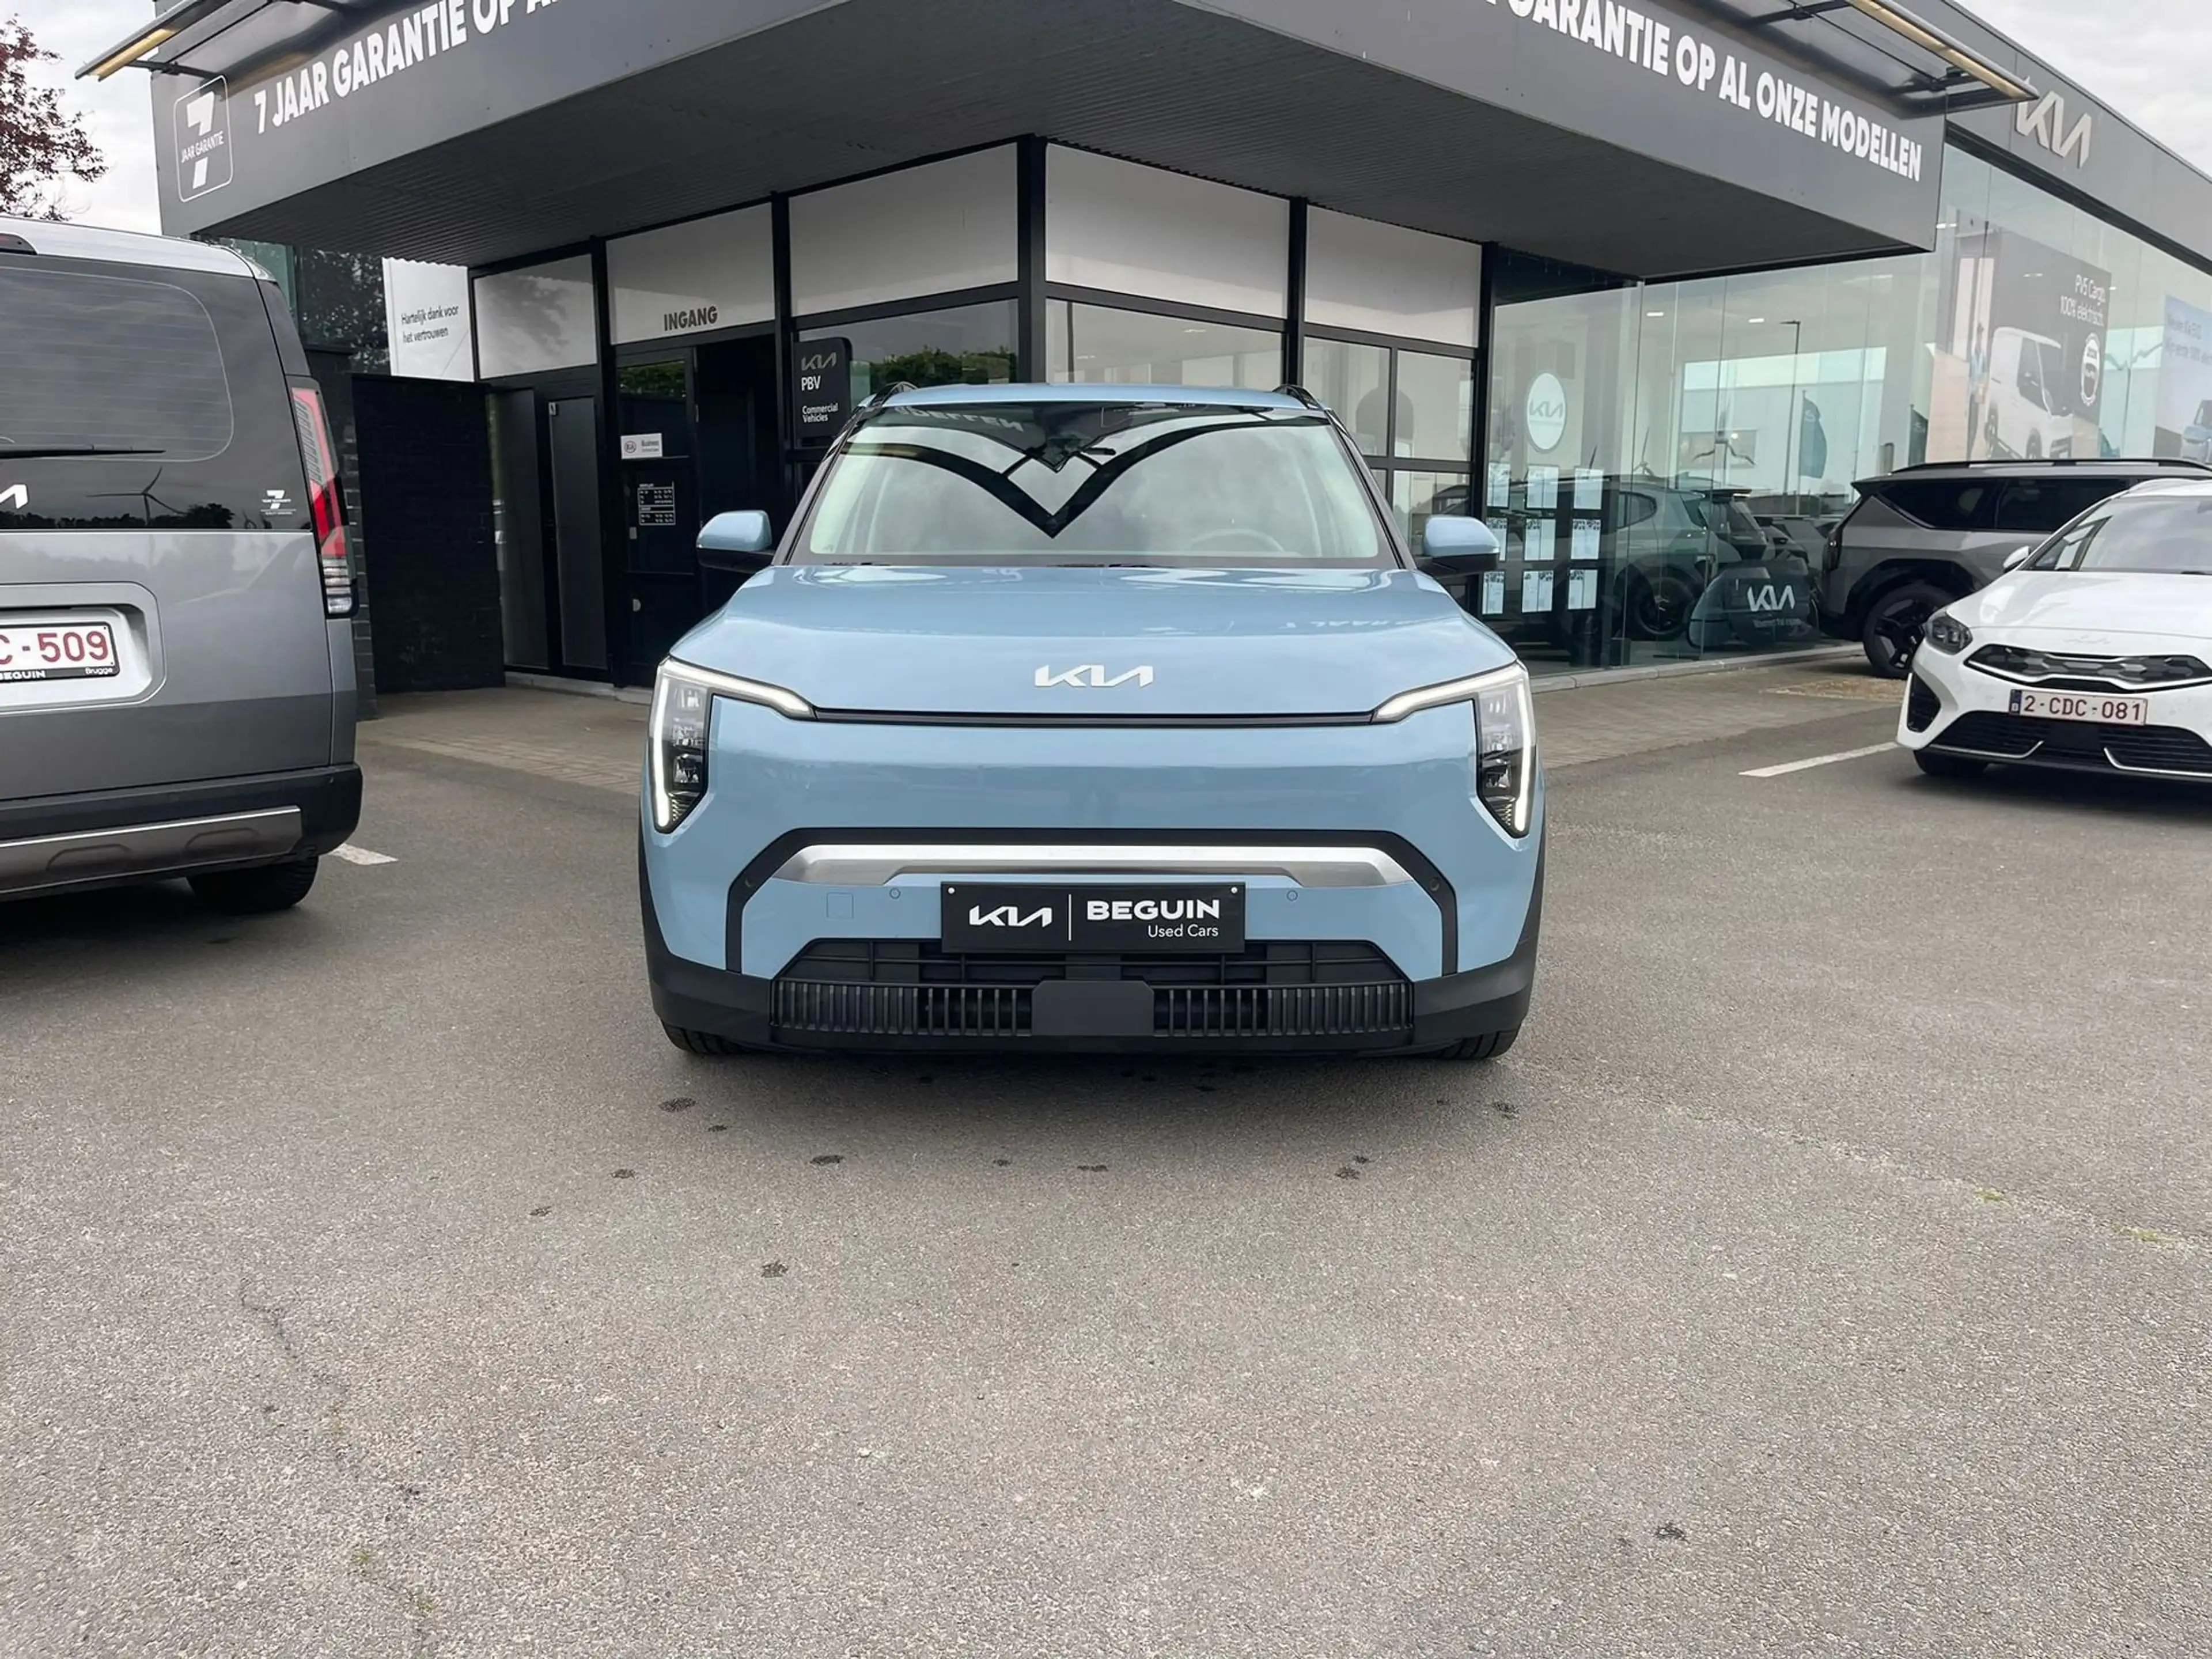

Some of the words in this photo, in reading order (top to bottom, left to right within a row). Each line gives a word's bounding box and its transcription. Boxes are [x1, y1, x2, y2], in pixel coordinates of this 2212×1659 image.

[255, 90, 266, 134] 7
[272, 62, 329, 127] JAAR
[333, 0, 467, 97] GARANTIE
[1676, 35, 1716, 91] OP
[1719, 55, 1751, 110] AL
[1756, 72, 1819, 138] ONZE
[1821, 100, 1923, 182] MODELLEN
[181, 145, 196, 163] JAAR
[196, 130, 224, 156] GARANTIE
[187, 90, 215, 189] 7
[401, 309, 427, 325] Hartelijk
[428, 305, 444, 320] dank
[444, 305, 459, 317] voor
[2061, 295, 2077, 317] 100%
[664, 306, 718, 331] INGANG
[403, 331, 413, 344] het
[414, 327, 449, 341] vertrouwen
[801, 352, 837, 371] KIA
[801, 376, 821, 392] PBV
[802, 403, 839, 414] Commercial
[802, 413, 828, 423] Vehicles
[85, 666, 113, 675] Brugge
[1035, 664, 1153, 688] KIA
[969, 905, 1052, 927] KIA
[1087, 899, 1219, 920] BEGUIN
[1148, 924, 1183, 938] Used
[1187, 924, 1219, 937] Cars
